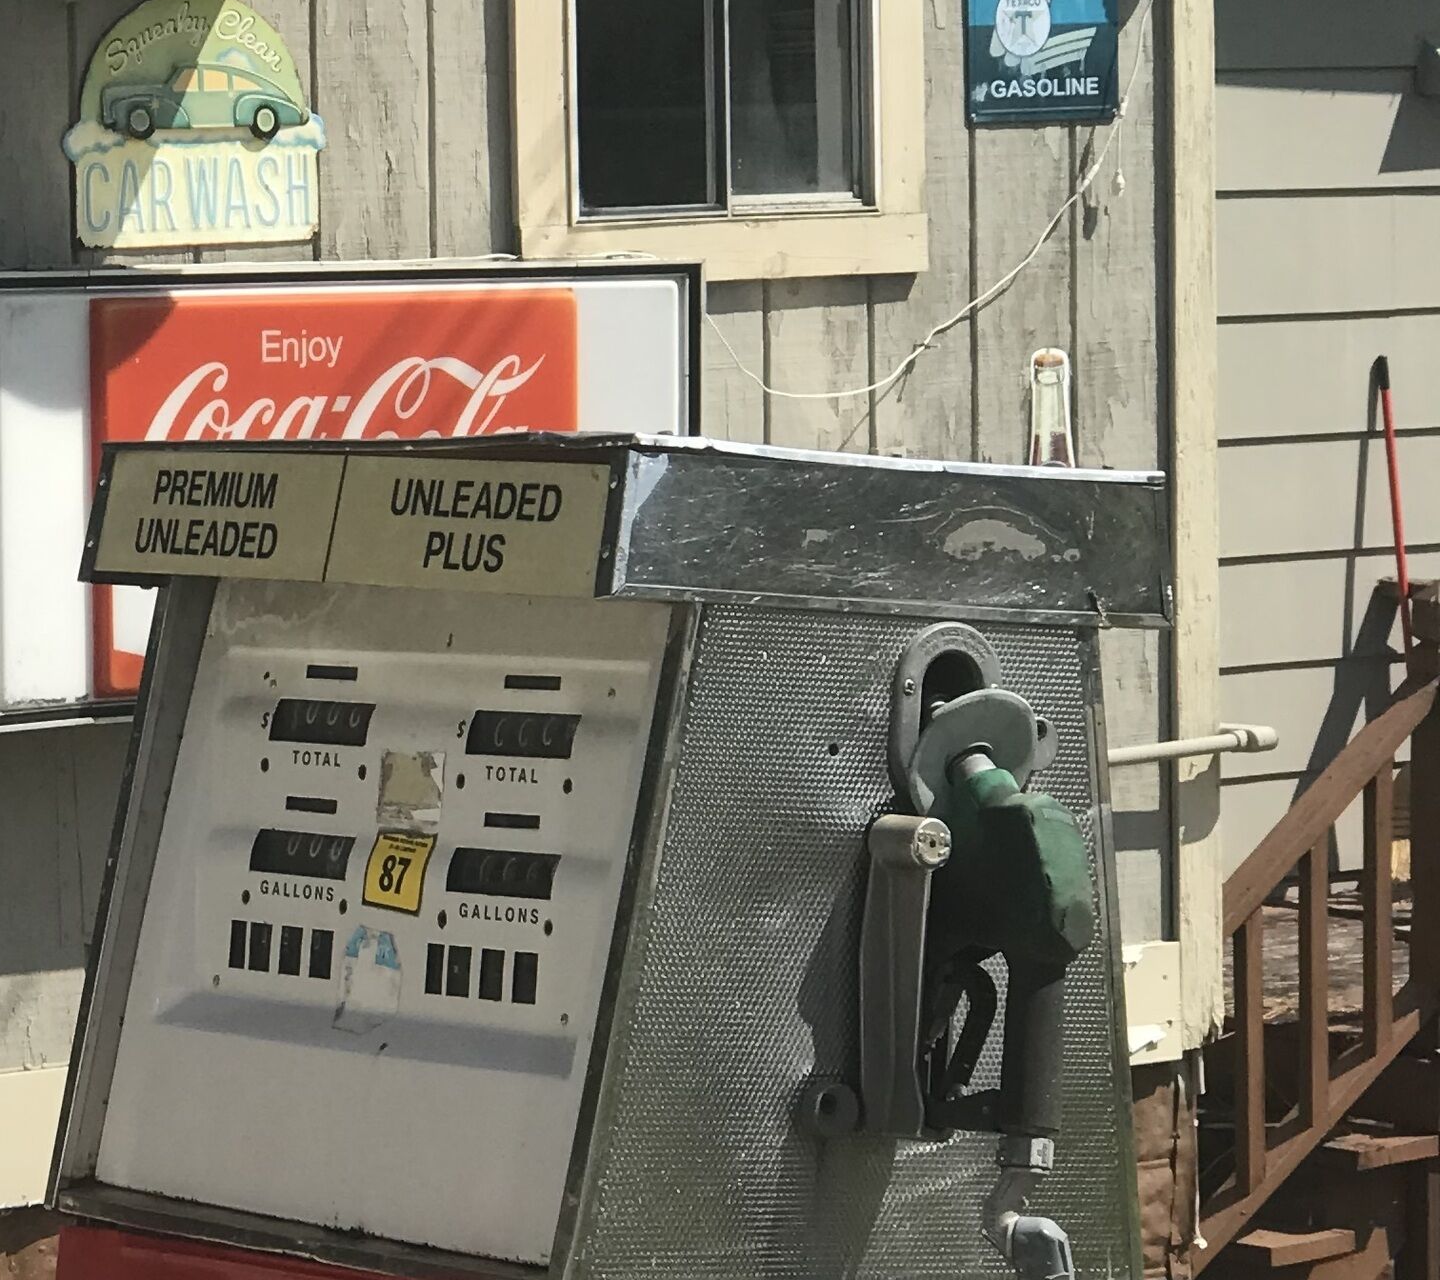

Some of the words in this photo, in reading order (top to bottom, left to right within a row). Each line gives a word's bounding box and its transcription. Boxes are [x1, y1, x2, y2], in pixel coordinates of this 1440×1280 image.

[104, 1, 211, 73] Squeaky
[214, 9, 282, 73] Clean
[990, 76, 1100, 99] GASOLINE
[84, 159, 178, 234] CAR
[186, 154, 311, 232] WASH
[261, 329, 344, 369] Enjoy
[143, 353, 546, 442] Coca-Cl
[153, 469, 279, 510] PREMIUM
[391, 478, 562, 523] UNLEADED
[134, 518, 279, 560] UNLEADED
[423, 532, 507, 573] PLUS
[292, 749, 342, 768] TOTAL
[485, 765, 539, 784] TOTAL
[260, 879, 334, 902] GALLONS
[378, 854, 412, 895] 87
[459, 902, 540, 925] GALLONS
